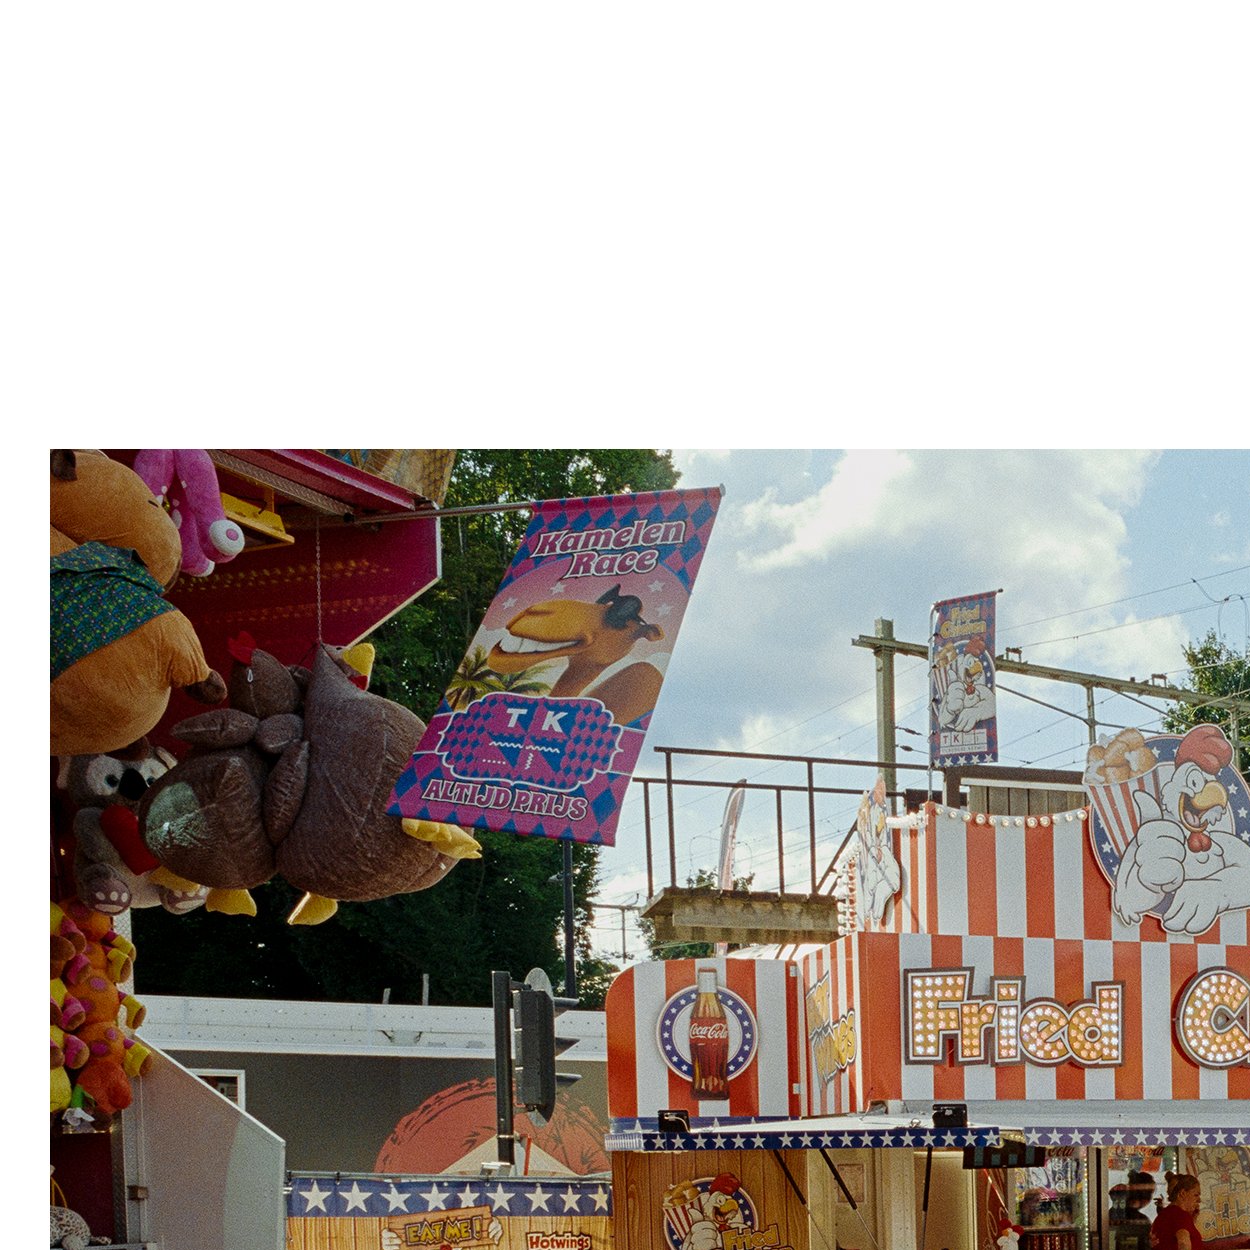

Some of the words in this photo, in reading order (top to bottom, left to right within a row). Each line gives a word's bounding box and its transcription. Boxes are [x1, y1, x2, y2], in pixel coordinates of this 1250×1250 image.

[530, 519, 686, 558] Kamelen
[561, 549, 659, 579] Race
[506, 708, 528, 728] T
[542, 710, 569, 733] K
[421, 778, 513, 812] ALTIJD
[511, 790, 588, 821] PRIJS
[690, 1022, 728, 1039] Coca-Cola
[904, 967, 1124, 1066] Fried
[406, 1219, 444, 1246] EAT
[722, 1223, 780, 1250] Fried
